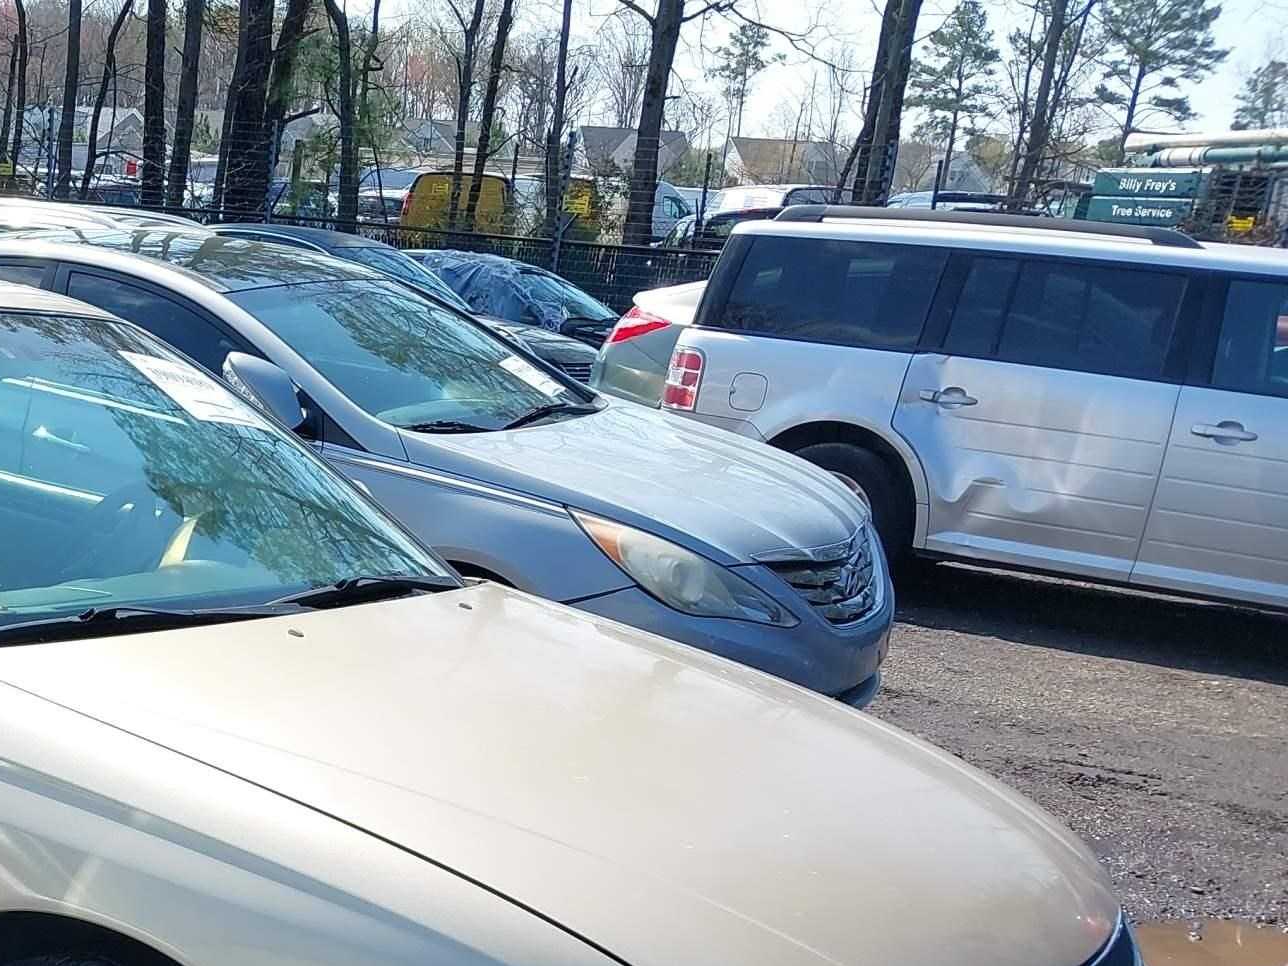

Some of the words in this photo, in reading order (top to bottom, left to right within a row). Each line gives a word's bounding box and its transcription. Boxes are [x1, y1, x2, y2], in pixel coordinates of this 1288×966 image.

[1119, 178, 1143, 193] Billy
[1144, 178, 1176, 193] Frey's
[1112, 204, 1132, 217] Tree
[1134, 205, 1173, 218] Service
